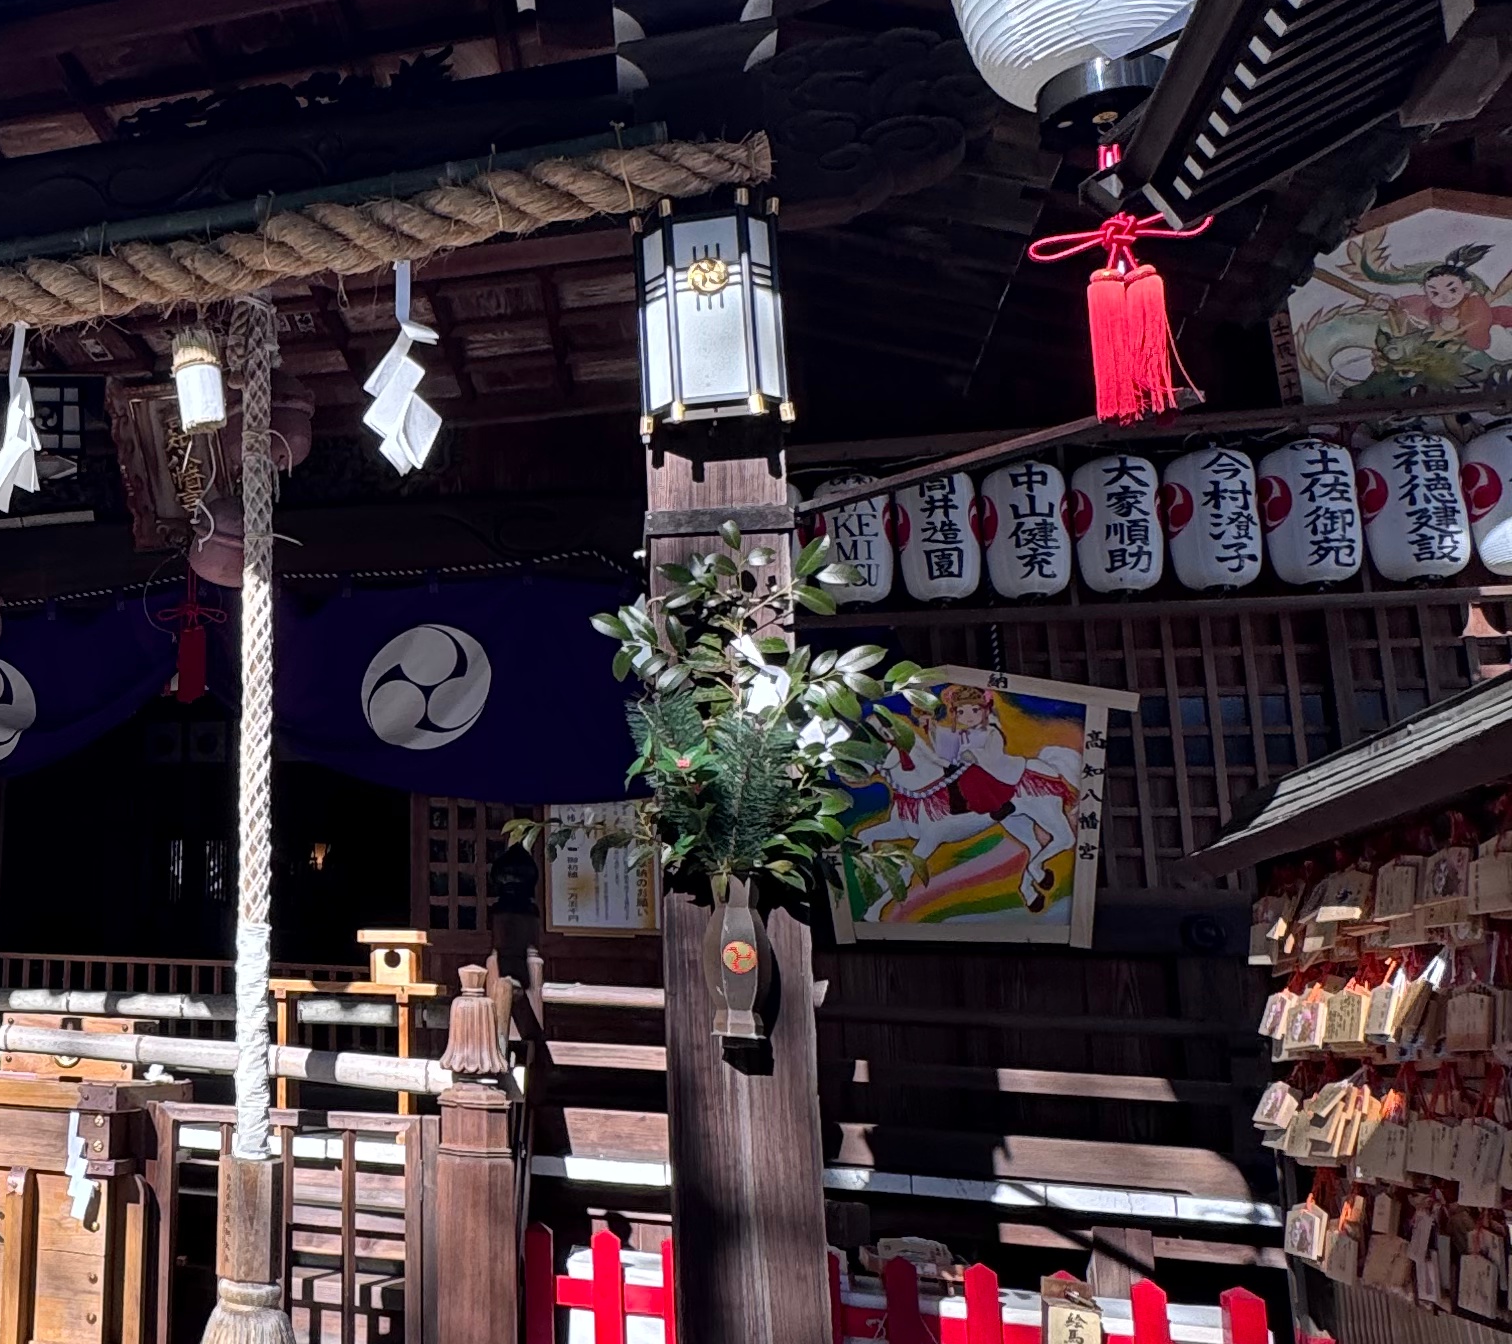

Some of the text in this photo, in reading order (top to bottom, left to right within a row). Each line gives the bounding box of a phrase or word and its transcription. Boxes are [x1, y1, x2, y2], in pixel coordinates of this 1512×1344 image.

[1007, 463, 1061, 579] 中山健充
[1103, 456, 1153, 573] 大家順助
[1201, 451, 1258, 573] 今村澄子
[1300, 448, 1356, 568] 土佐御苑
[1079, 729, 1107, 862] 高知八幡宮
